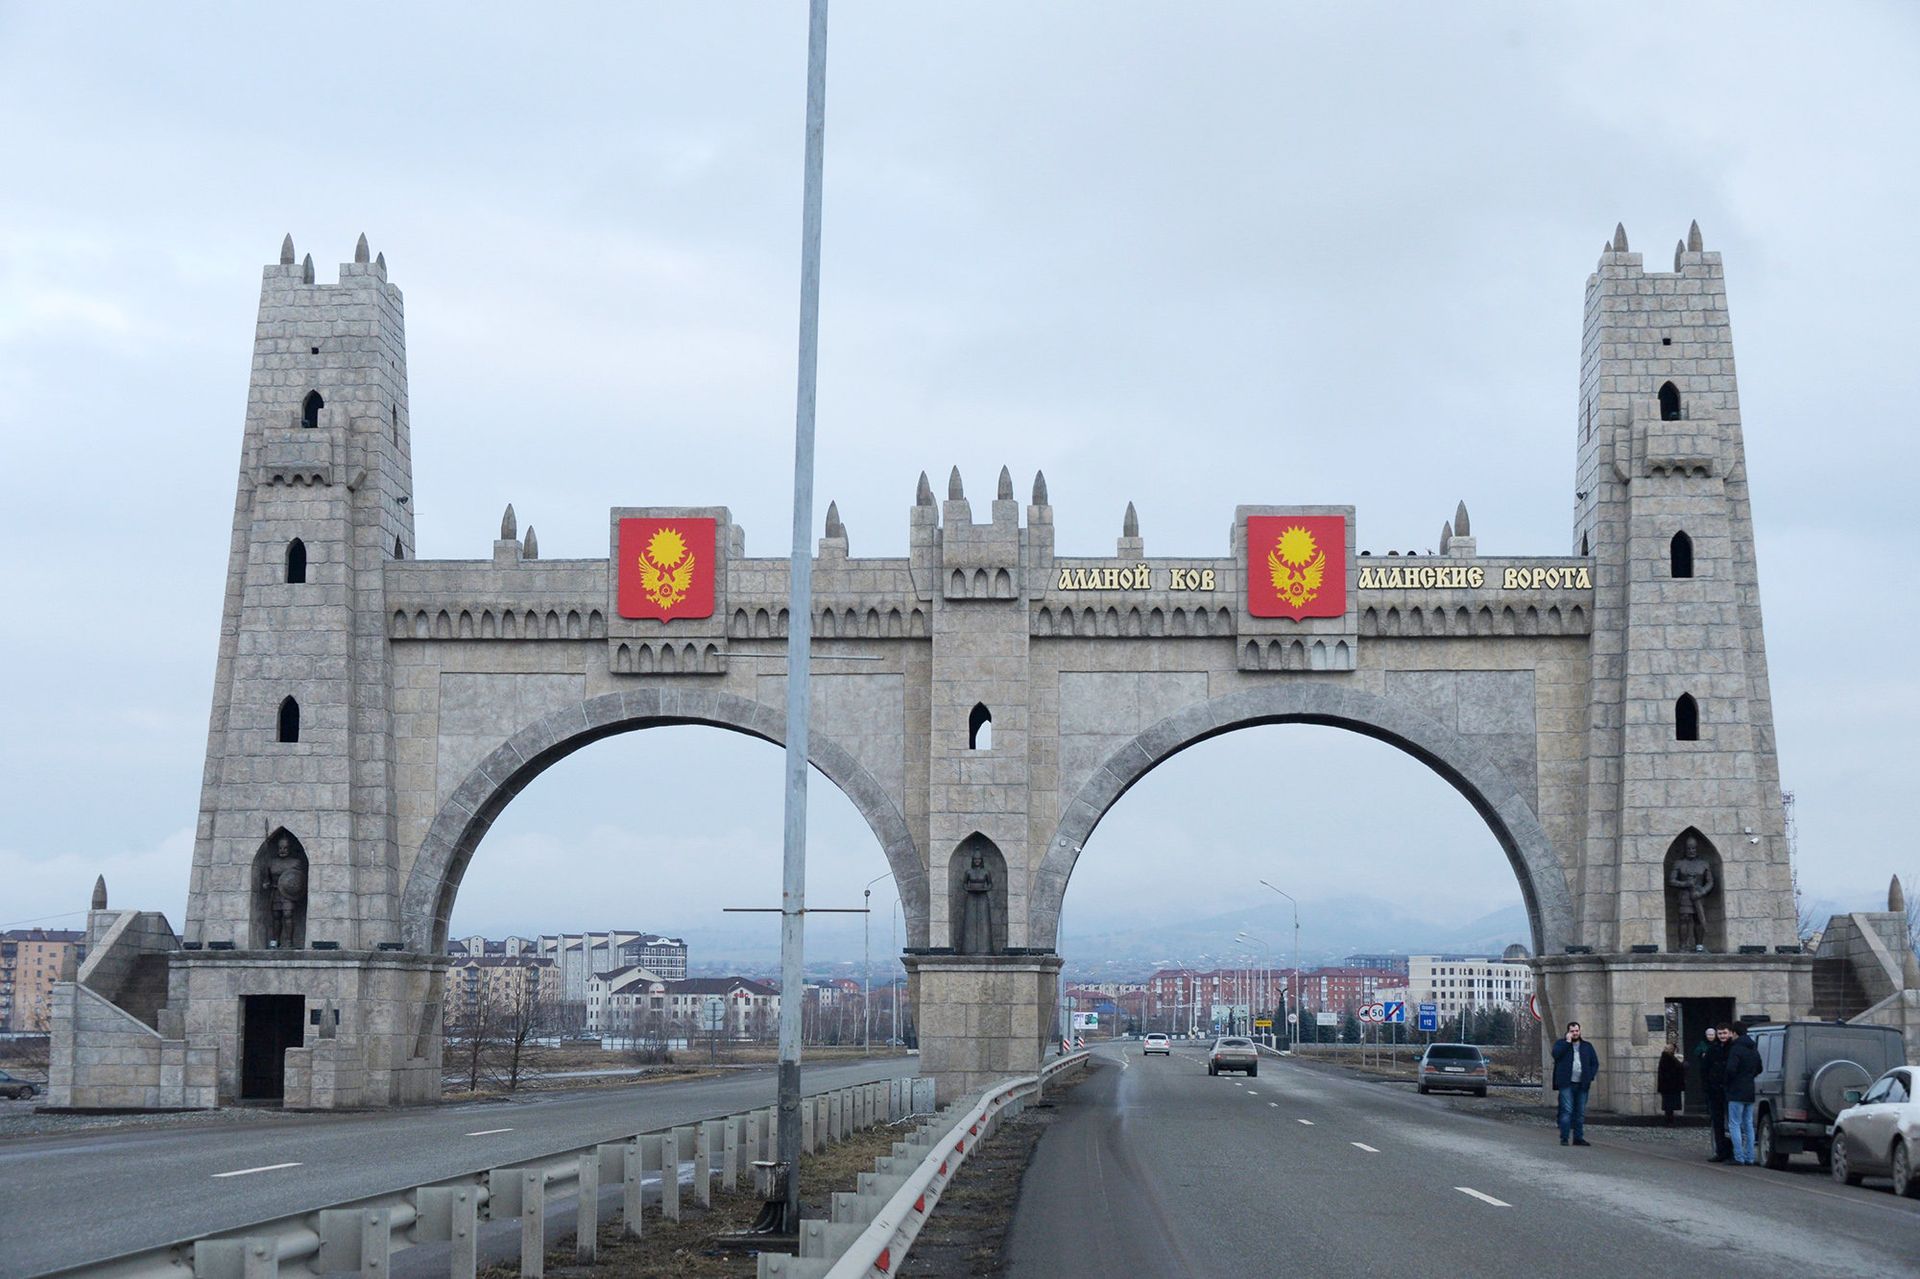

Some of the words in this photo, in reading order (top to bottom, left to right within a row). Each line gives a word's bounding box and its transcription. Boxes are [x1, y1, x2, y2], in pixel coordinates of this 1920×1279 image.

[1058, 563, 1151, 590] АЛАНОЙ
[1169, 568, 1216, 590] КОВ
[1358, 567, 1485, 589] АЛАНСКИЕ
[1502, 567, 1592, 589] ВОРОТА
[1371, 1009, 1383, 1017] 50
